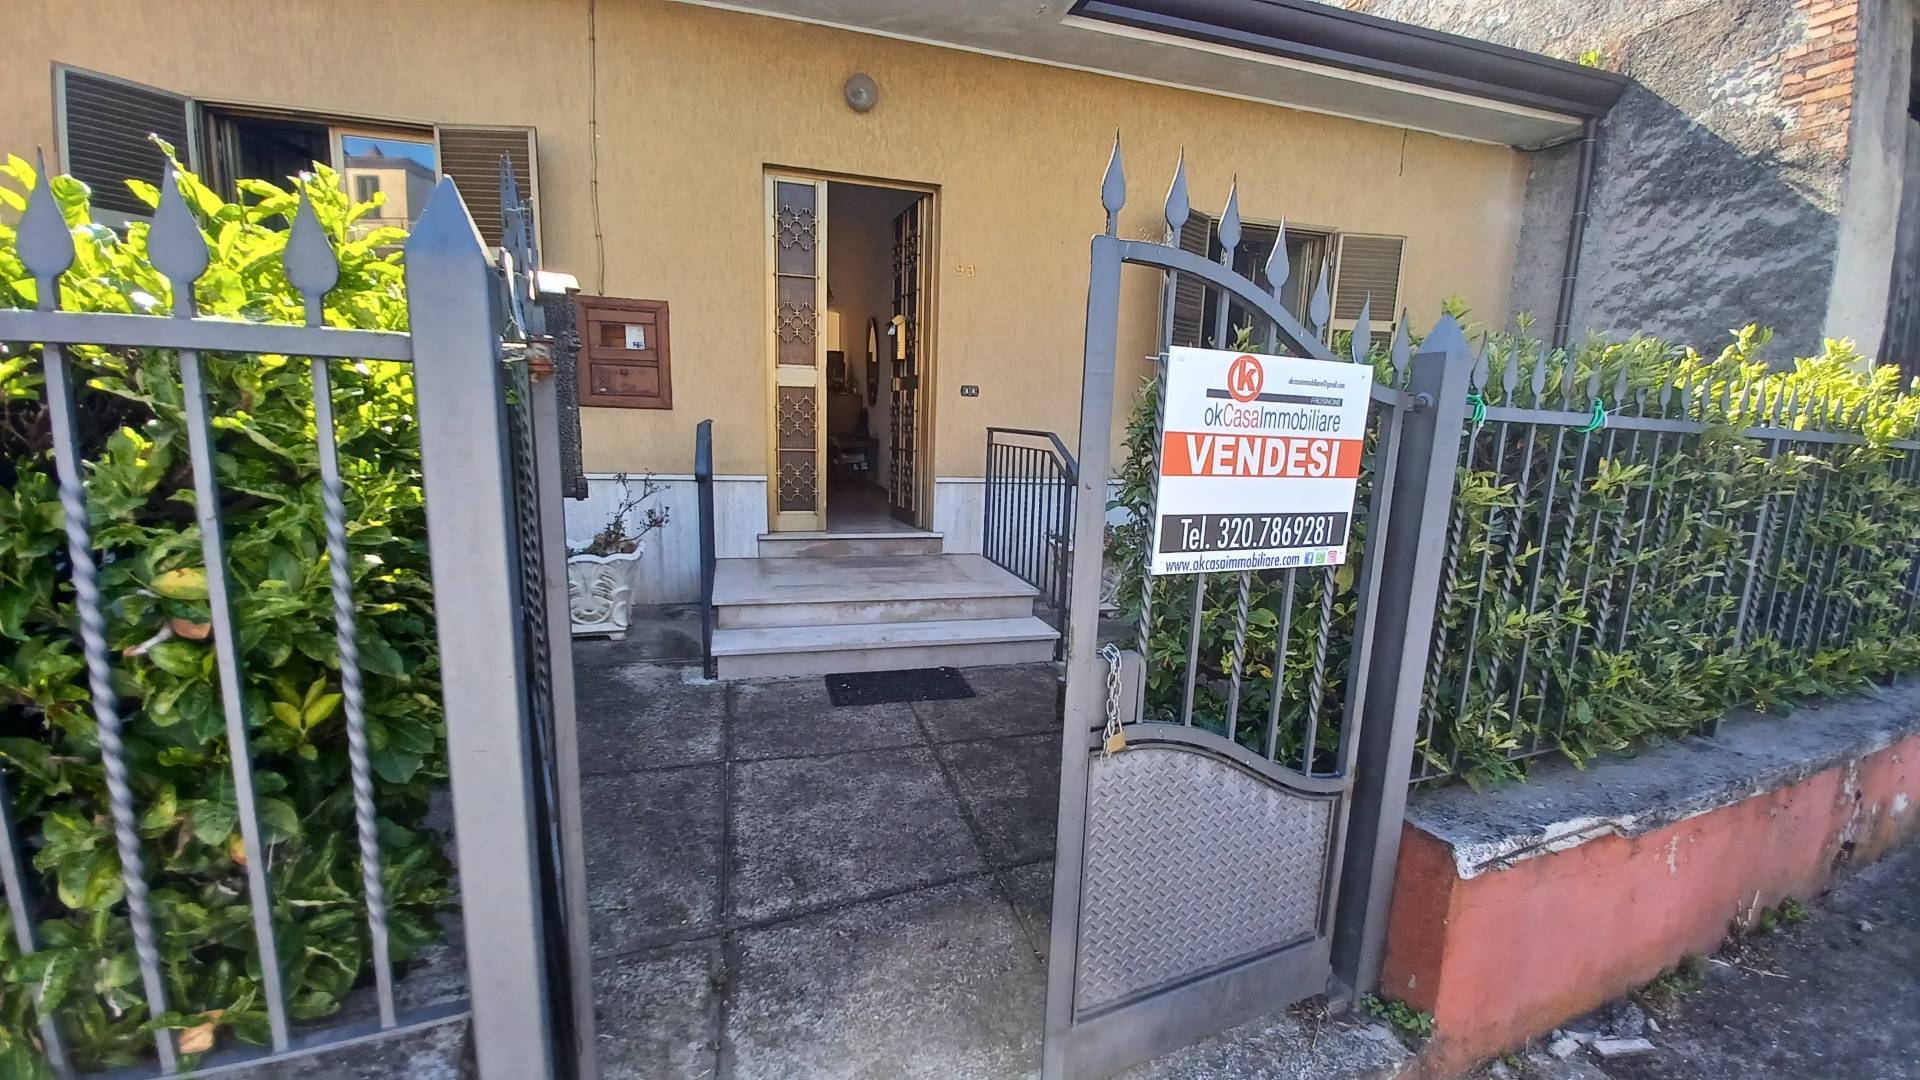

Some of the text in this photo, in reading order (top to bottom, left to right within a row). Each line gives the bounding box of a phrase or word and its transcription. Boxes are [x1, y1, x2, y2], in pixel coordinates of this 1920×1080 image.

[954, 263, 975, 277] 93
[1204, 403, 1341, 432] okCasaImmobiliare
[1185, 434, 1342, 477] VENDESI
[1181, 515, 1334, 550] Tel. 320.7869281
[1165, 552, 1300, 572] www.okcasaimmobiliare.com
